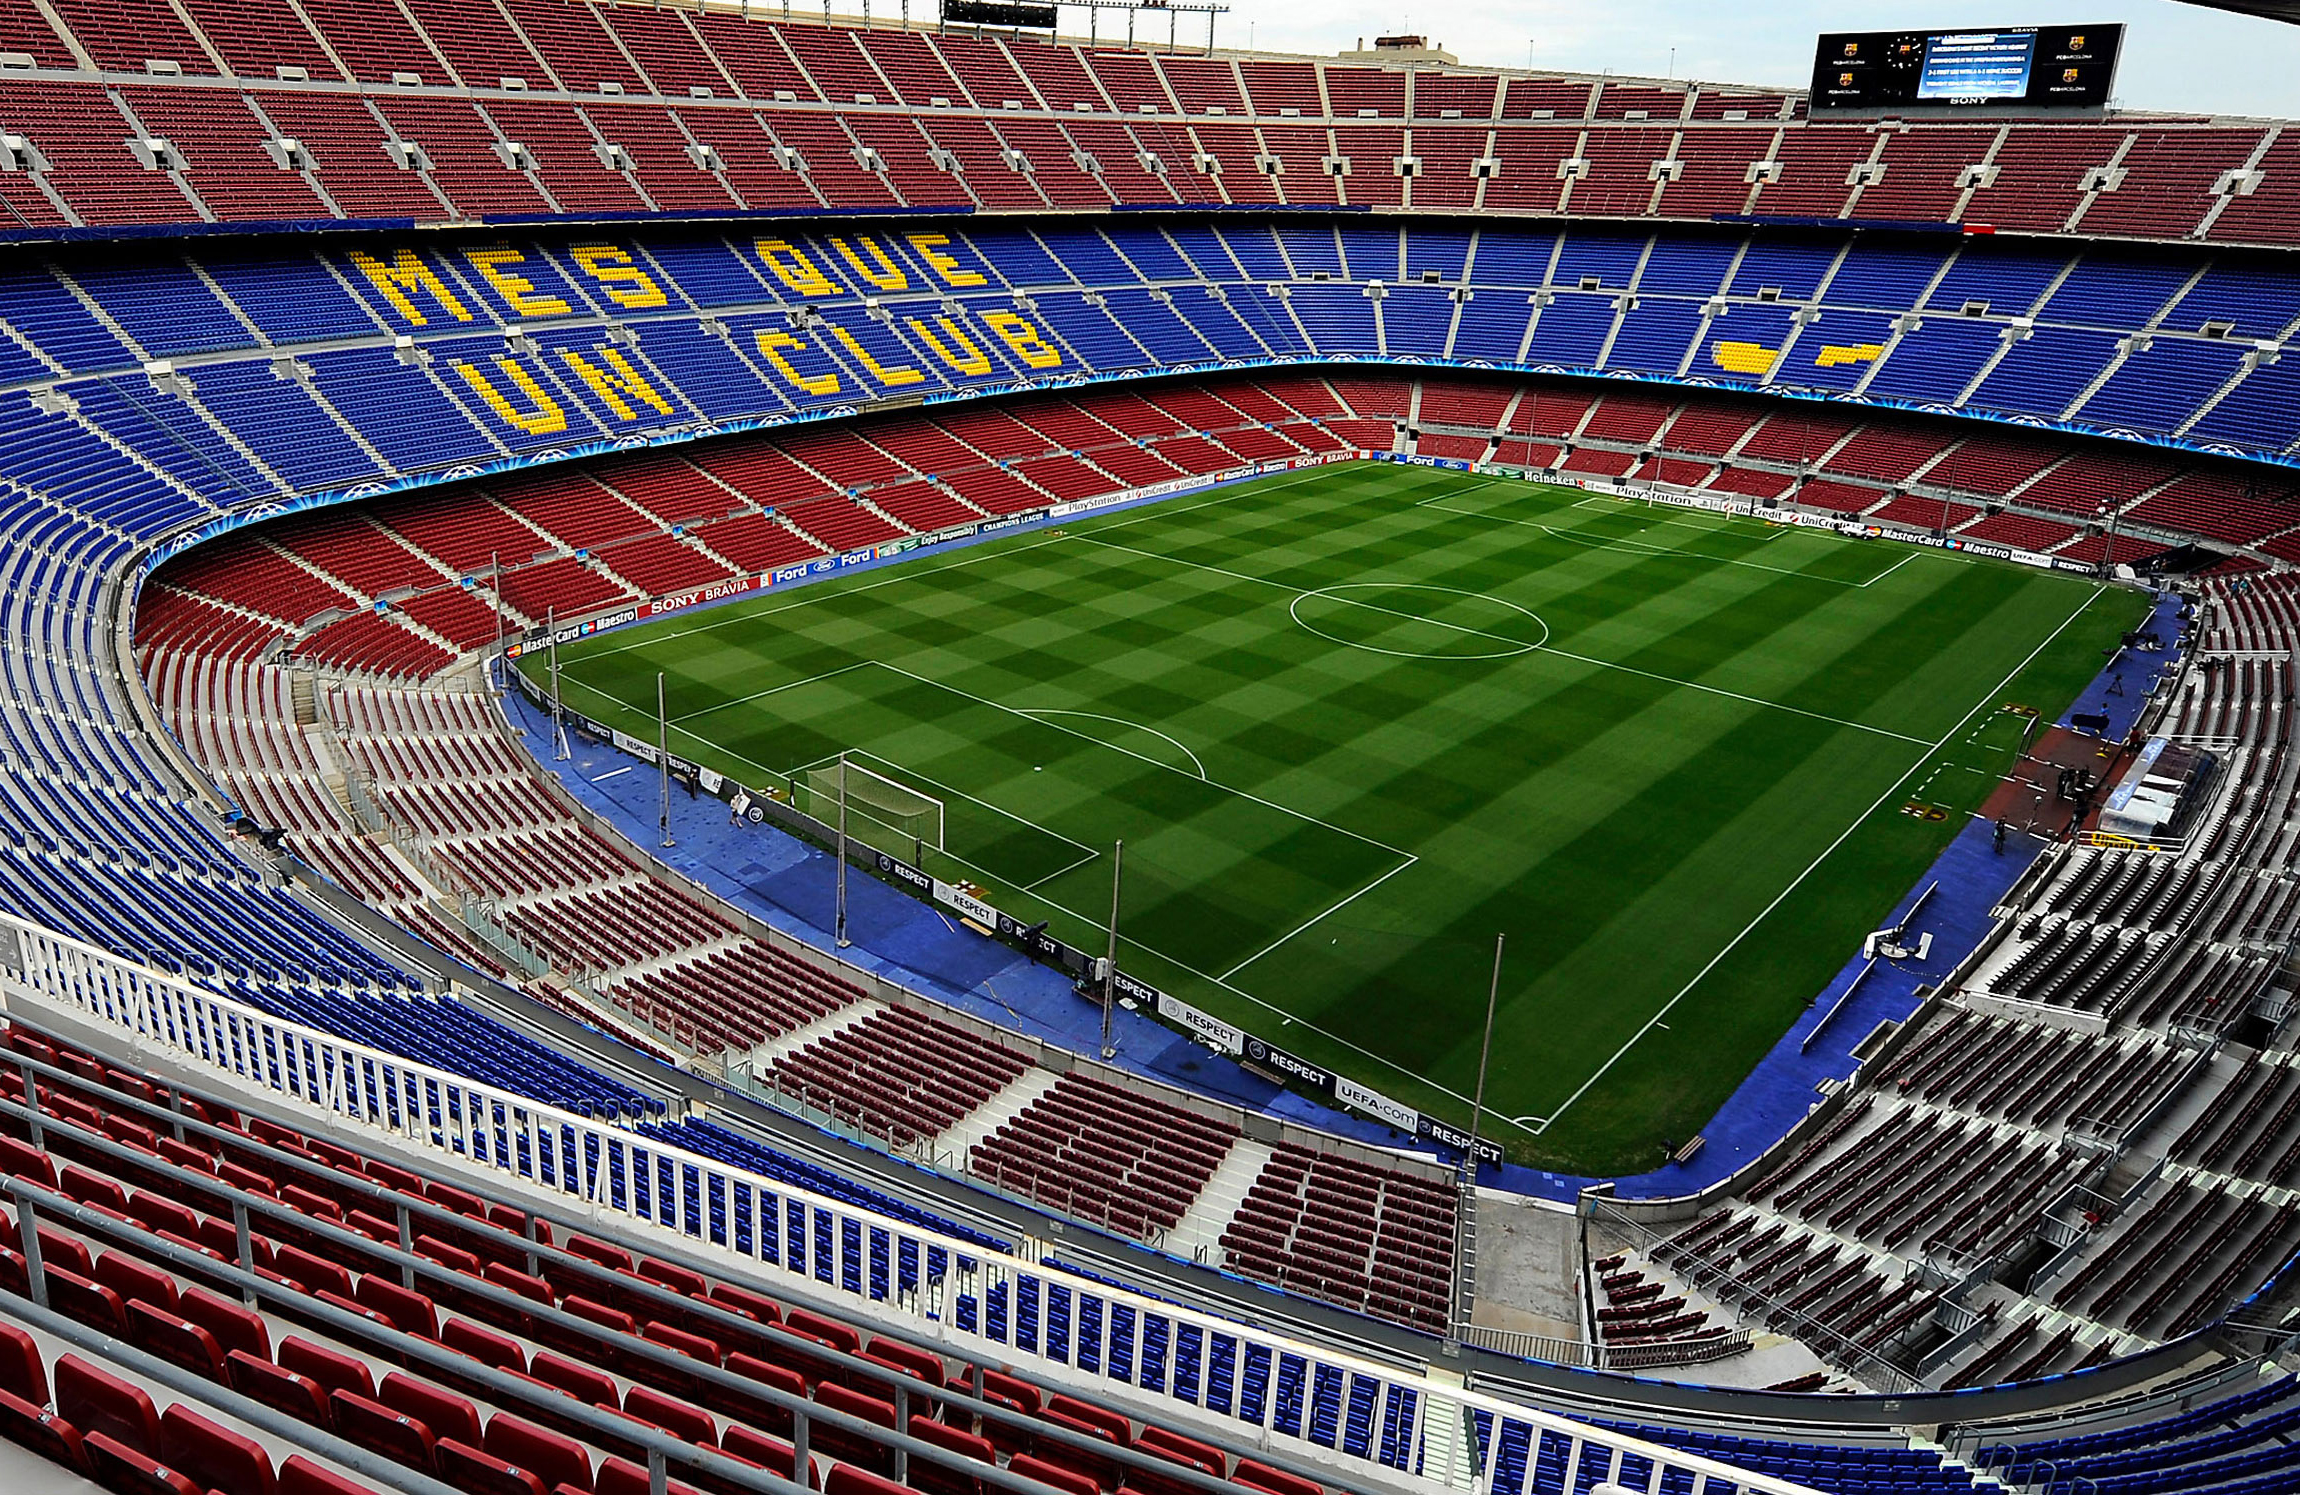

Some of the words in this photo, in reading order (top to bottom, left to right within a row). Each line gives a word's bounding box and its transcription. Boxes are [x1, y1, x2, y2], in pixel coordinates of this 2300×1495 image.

[1950, 97, 1988, 105] SONY
[348, 243, 667, 325] MES
[753, 233, 988, 296] QUE
[455, 344, 674, 436] UN
[757, 310, 1062, 396] CLUB
[1295, 456, 1324, 468] SONY
[1327, 452, 1353, 464] BRAVIA
[1406, 455, 1434, 467] Ford
[1524, 471, 1576, 487] Heineken
[1142, 484, 1172, 497] UniCredit
[1068, 494, 1121, 513] PlayStation
[1735, 504, 1782, 520] UnCredit
[1021, 512, 1044, 525] LEAGUE
[921, 534, 938, 546] Enjoy
[1881, 528, 1945, 548] MasterCard
[840, 550, 871, 567] Ford
[1963, 542, 2009, 559] Maestro
[776, 565, 807, 583] Ford
[2057, 561, 2091, 574] RESPECT
[651, 592, 699, 614] SONY
[705, 580, 749, 600] BRAVIA
[596, 610, 635, 631] Maestro
[626, 739, 652, 757] RESPECT
[894, 863, 930, 889] RESPECT
[953, 893, 990, 920] RESPECT
[1114, 975, 1152, 1003] ESPECT
[1185, 1011, 1236, 1043] RESPECT
[1270, 1051, 1326, 1086] RESPECT
